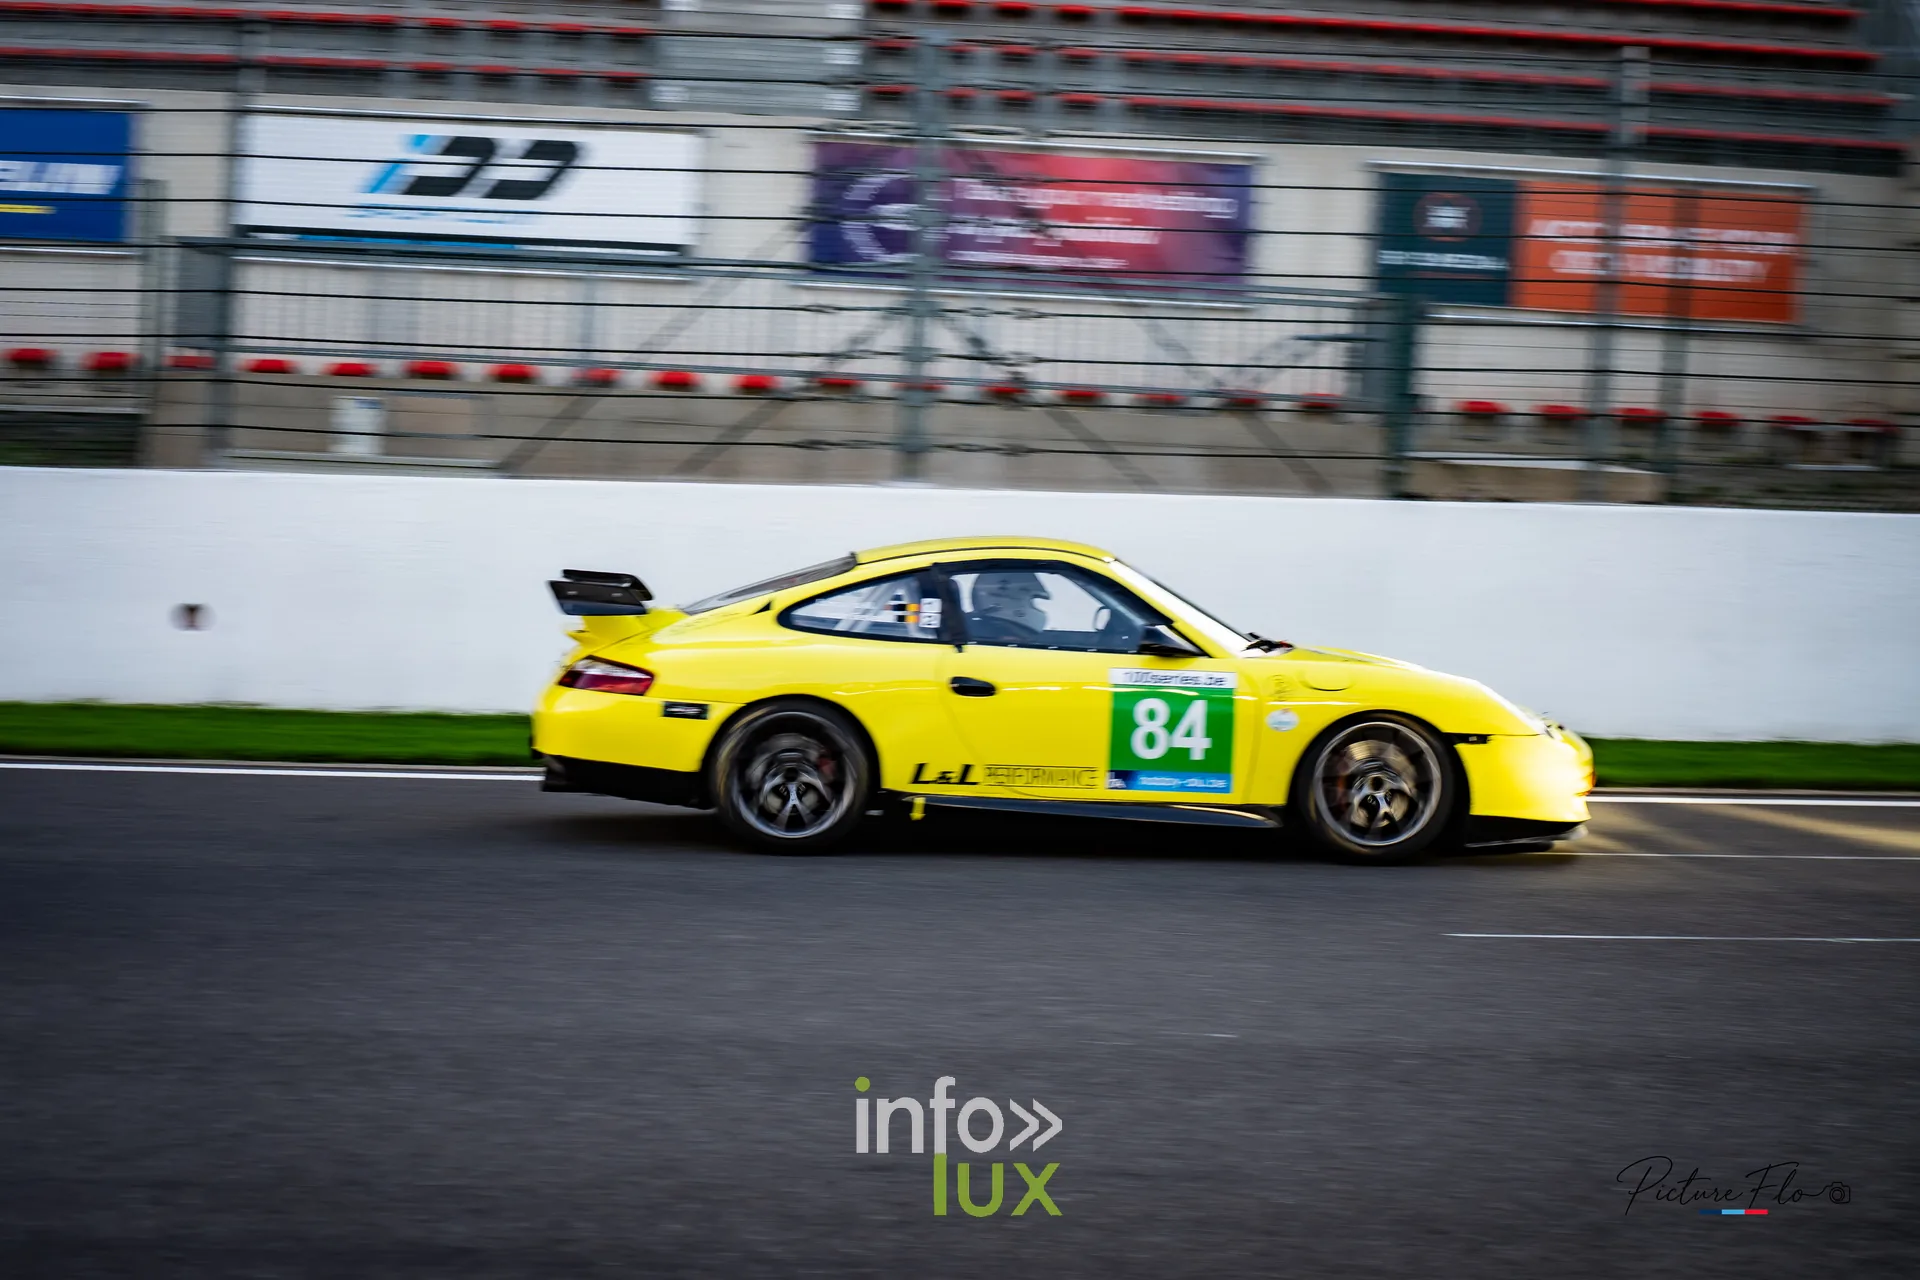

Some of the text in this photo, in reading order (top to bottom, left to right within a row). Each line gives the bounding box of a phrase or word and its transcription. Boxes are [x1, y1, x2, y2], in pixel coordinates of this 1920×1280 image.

[1130, 698, 1213, 760] 84
[909, 762, 981, 786] L&L
[984, 766, 1099, 788] PERFORMANCE
